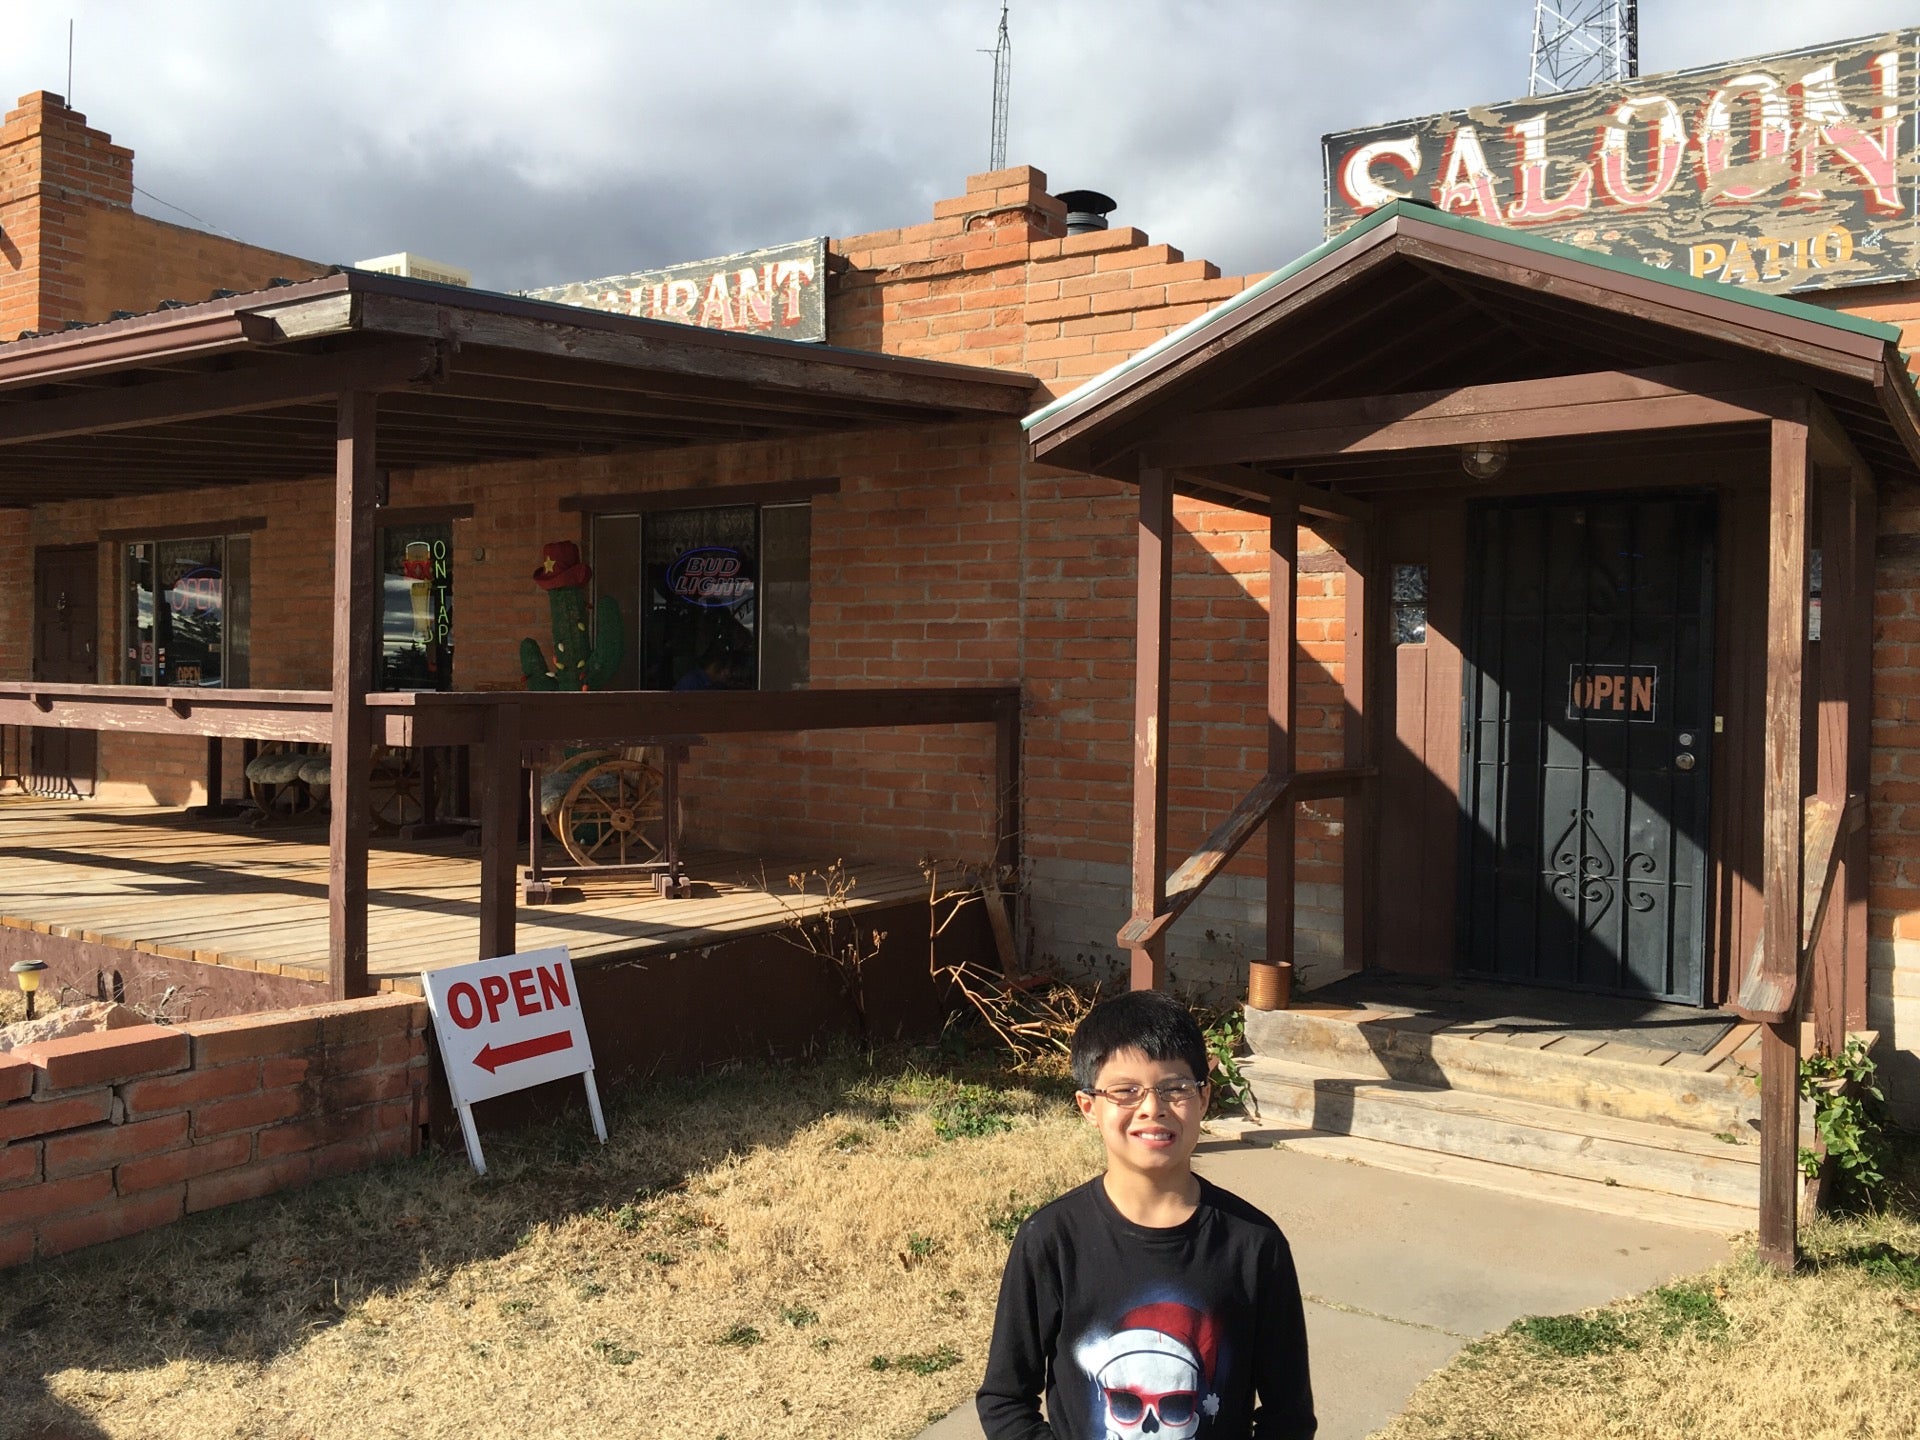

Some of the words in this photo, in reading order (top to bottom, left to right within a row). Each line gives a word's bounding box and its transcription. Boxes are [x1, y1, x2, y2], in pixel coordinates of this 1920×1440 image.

[1338, 52, 1904, 226] SALOON
[1690, 225, 1853, 283] PATIO
[433, 540, 447, 579] ON
[685, 557, 741, 576] BUD
[172, 578, 222, 611] OPEN
[674, 576, 750, 597] LIGHT
[436, 585, 449, 644] TAP
[1573, 675, 1652, 711] OPEN
[447, 963, 571, 1030] OPEN
